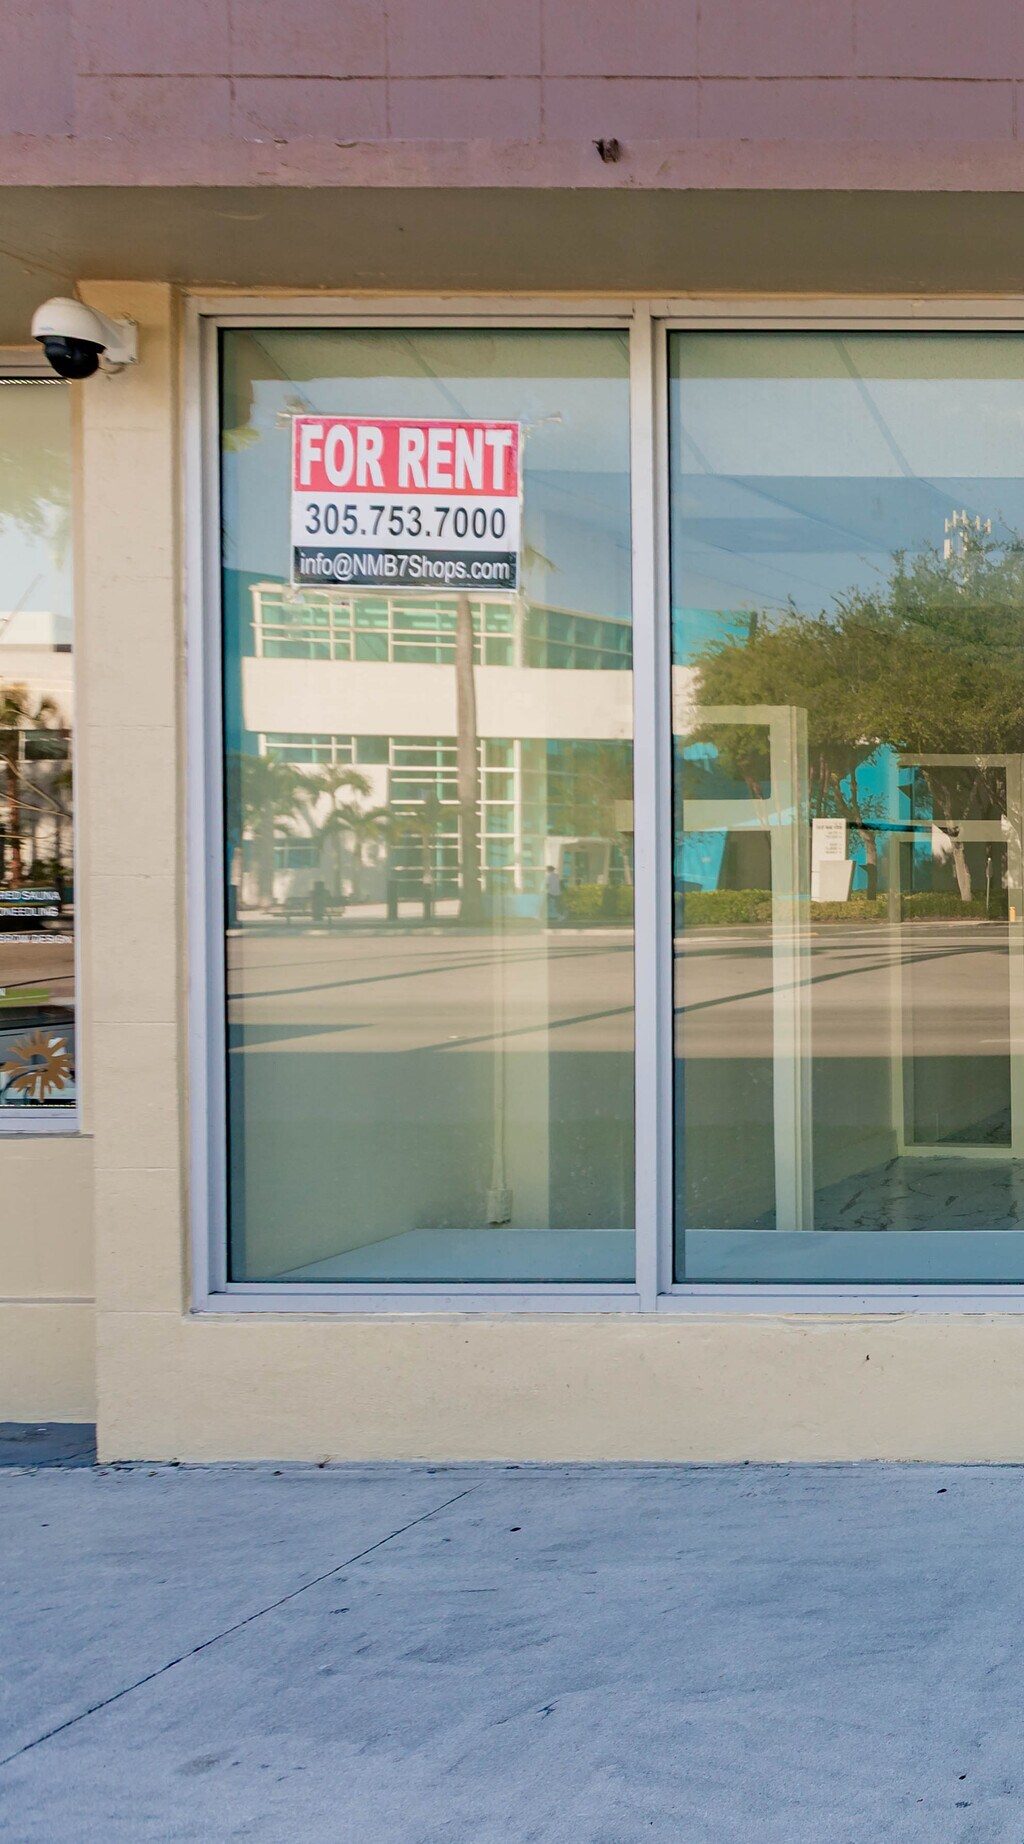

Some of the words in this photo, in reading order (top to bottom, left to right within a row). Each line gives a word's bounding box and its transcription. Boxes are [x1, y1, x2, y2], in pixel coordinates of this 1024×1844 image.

[300, 424, 386, 487] FOR
[398, 426, 513, 490] RENT
[304, 502, 506, 539] 305.753.7000
[299, 552, 511, 583] info@NMB7Shops.com
[21, 890, 61, 901] SAUNA
[32, 934, 73, 944] DESIGN
